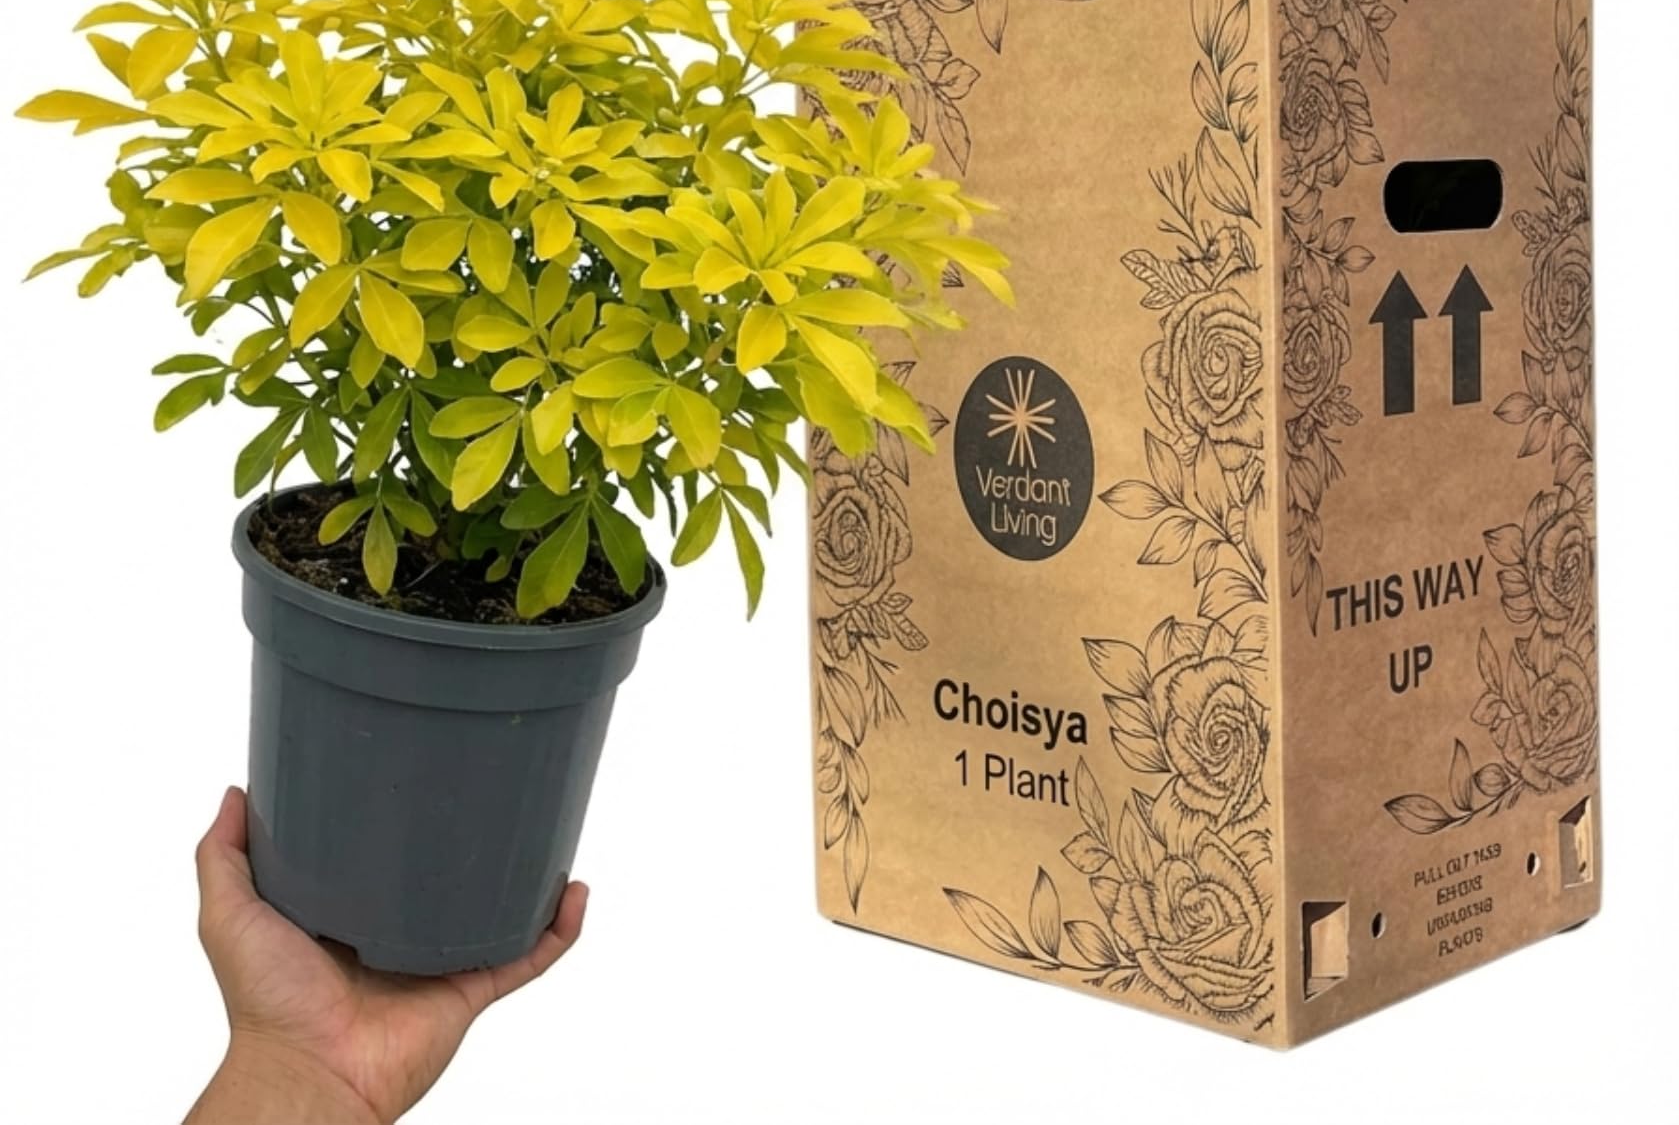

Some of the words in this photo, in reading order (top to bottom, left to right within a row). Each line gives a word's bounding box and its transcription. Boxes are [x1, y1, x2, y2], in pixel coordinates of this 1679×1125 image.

[975, 464, 1071, 507] Verdant
[991, 501, 1056, 546] Living
[1326, 574, 1404, 631] THIS
[1412, 555, 1483, 611] WAY
[1390, 644, 1433, 694] UP
[933, 678, 1088, 750] Choisya
[955, 749, 967, 786] 1
[985, 753, 1070, 807] Plant
